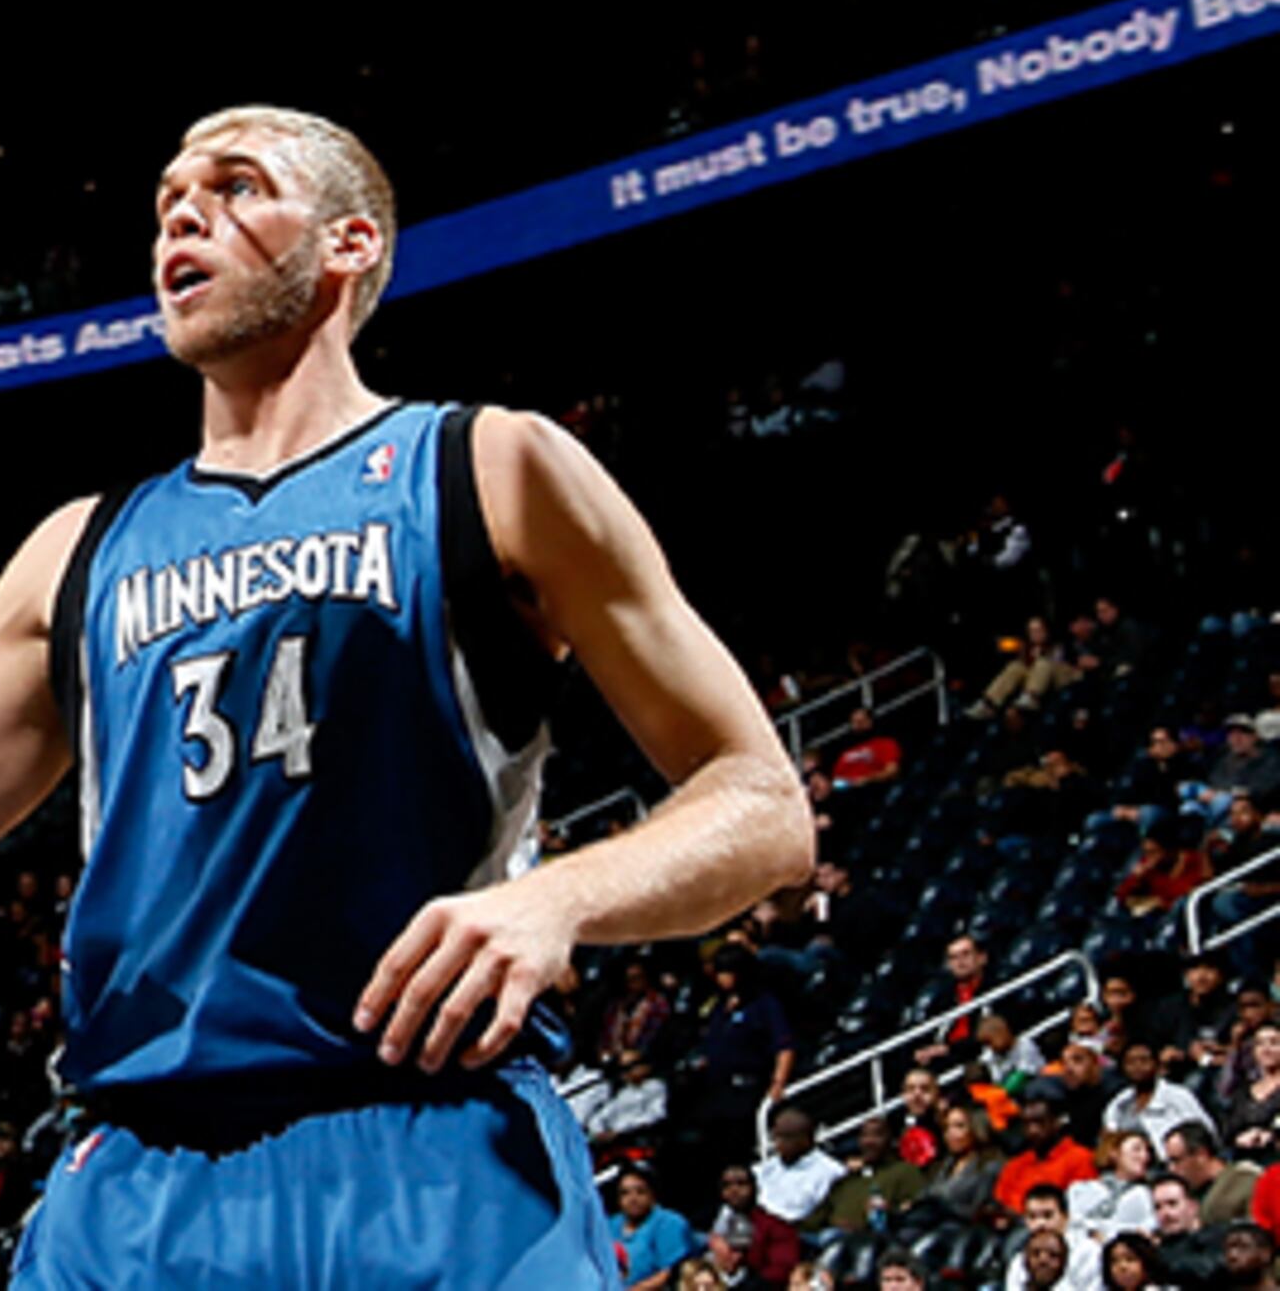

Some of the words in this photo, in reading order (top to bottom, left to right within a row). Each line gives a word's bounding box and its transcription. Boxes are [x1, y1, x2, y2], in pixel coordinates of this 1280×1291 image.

[611, 170, 646, 208] It
[654, 132, 767, 196] must
[774, 116, 837, 158] be
[846, 82, 967, 134] true,
[977, 9, 1178, 95] Nobody
[112, 522, 397, 668] MINNESOTA
[172, 636, 317, 801] 34
